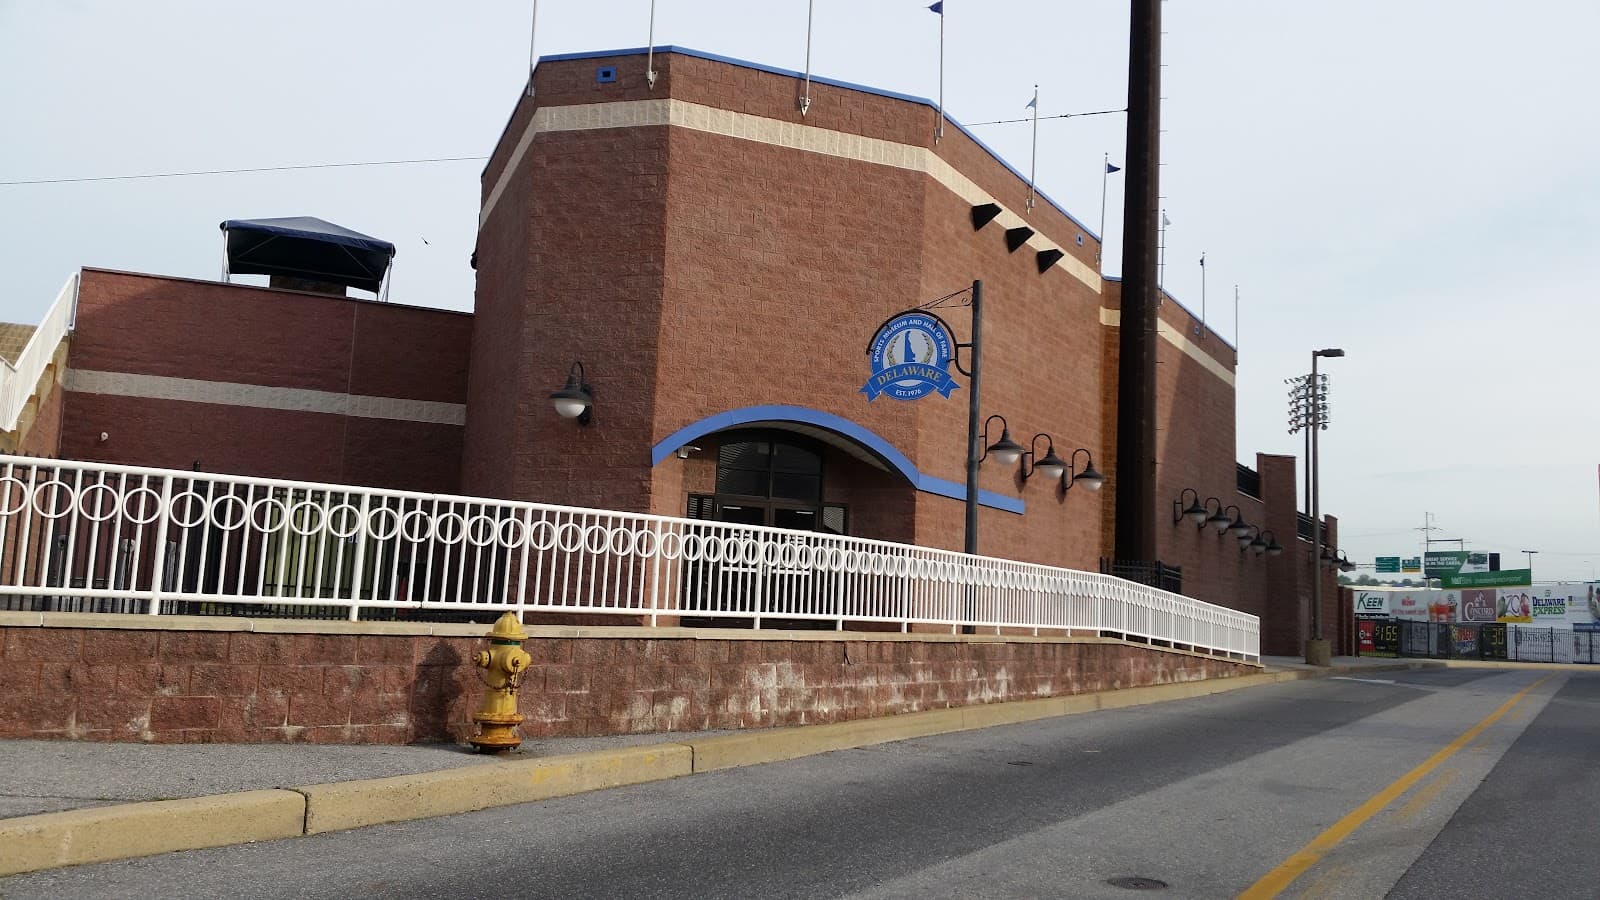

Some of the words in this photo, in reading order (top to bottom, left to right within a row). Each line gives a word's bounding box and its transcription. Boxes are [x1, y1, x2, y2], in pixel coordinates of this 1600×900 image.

[874, 339, 884, 362] SPORTS
[883, 320, 907, 339] MUSEUM
[923, 321, 936, 332] HALL
[935, 331, 944, 341] OF
[877, 365, 943, 385] DELAWARE
[1357, 592, 1384, 610] KEEN
[1532, 596, 1566, 607] DELAWARE
[1464, 601, 1495, 621] CONCORD
[1532, 606, 1566, 617] EXPRESS
